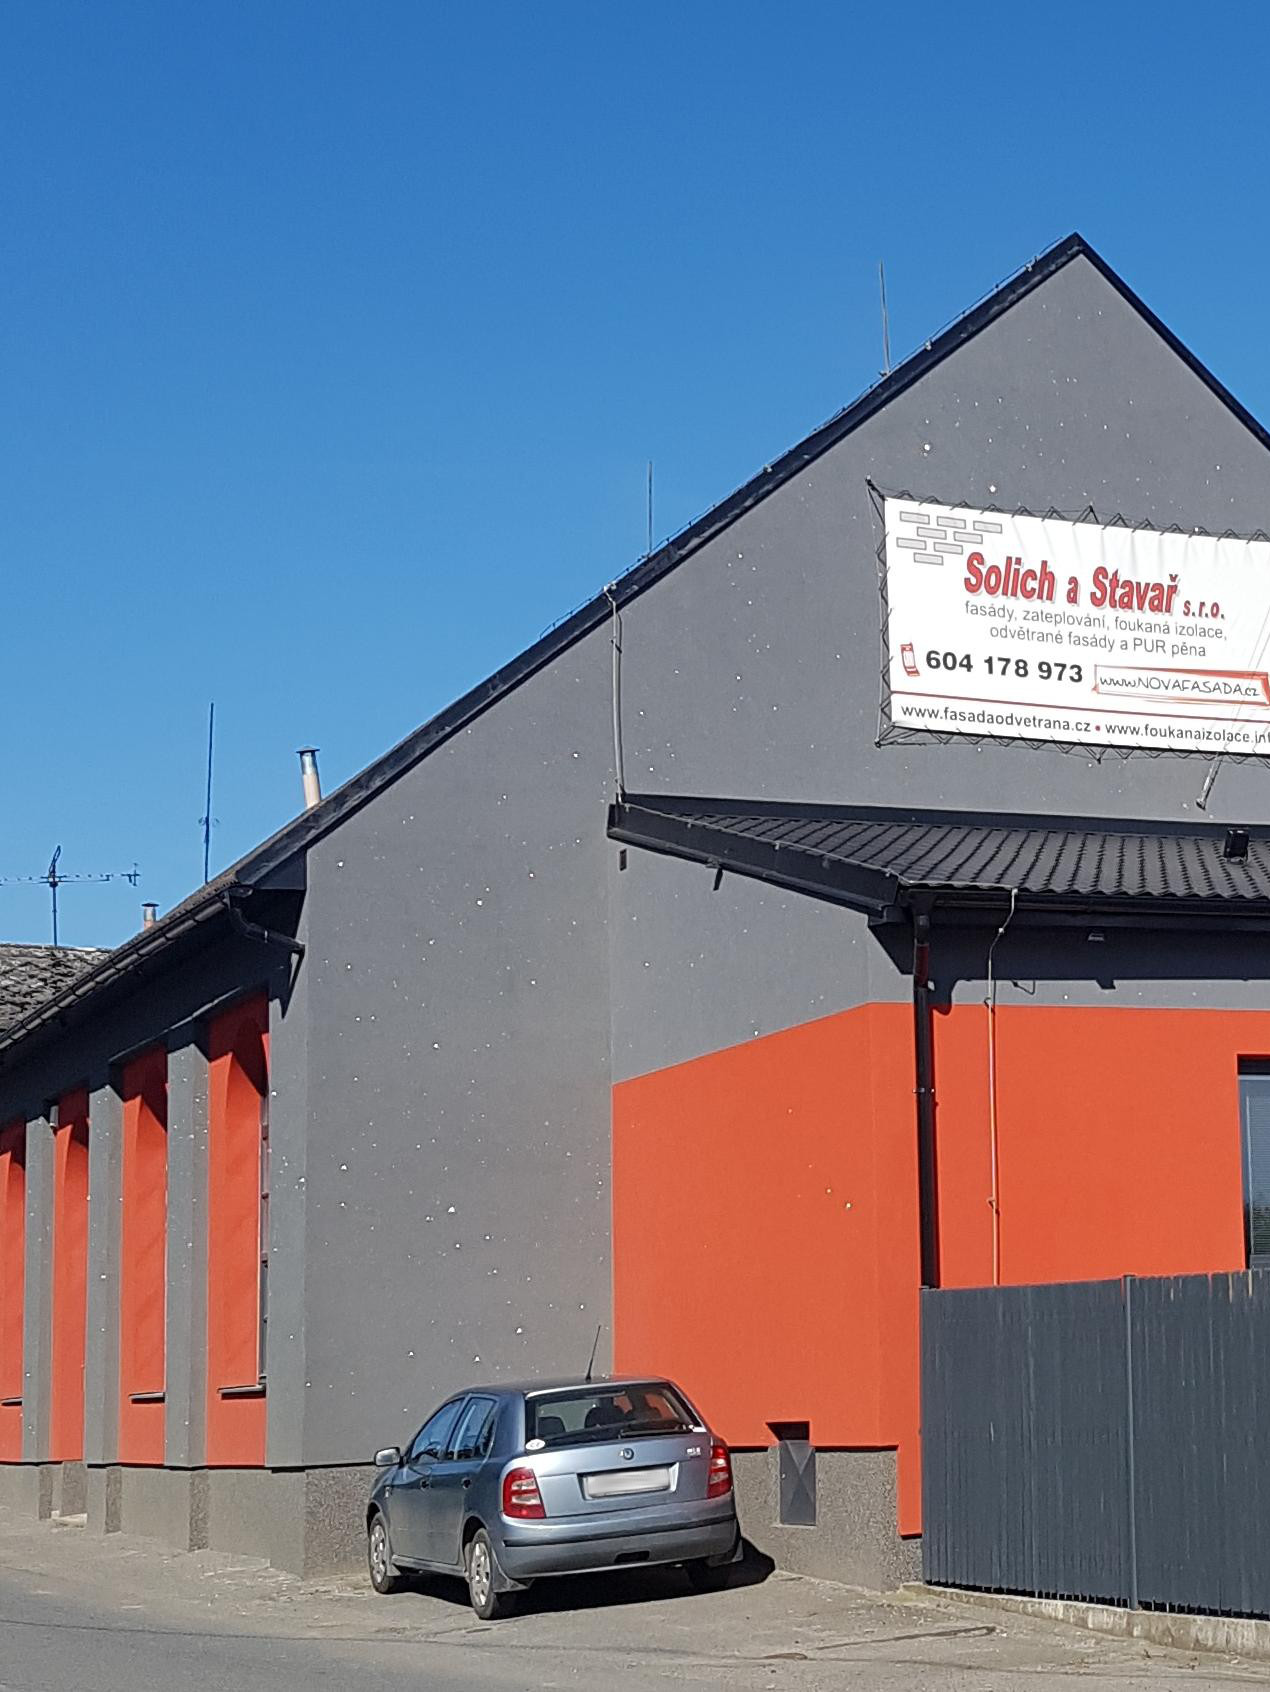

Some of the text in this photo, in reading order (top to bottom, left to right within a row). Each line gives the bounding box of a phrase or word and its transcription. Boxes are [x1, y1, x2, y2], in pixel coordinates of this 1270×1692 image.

[964, 552, 1226, 619] Solich a Stavař s.r.o.
[965, 600, 1228, 641] fasády, zateplování, foukaná izolace,
[990, 624, 1206, 658] odvětrané fasády a PUR pěna
[926, 650, 1083, 683] 604 178 973
[901, 706, 1091, 733] www.fasadaodvetrana.cz
